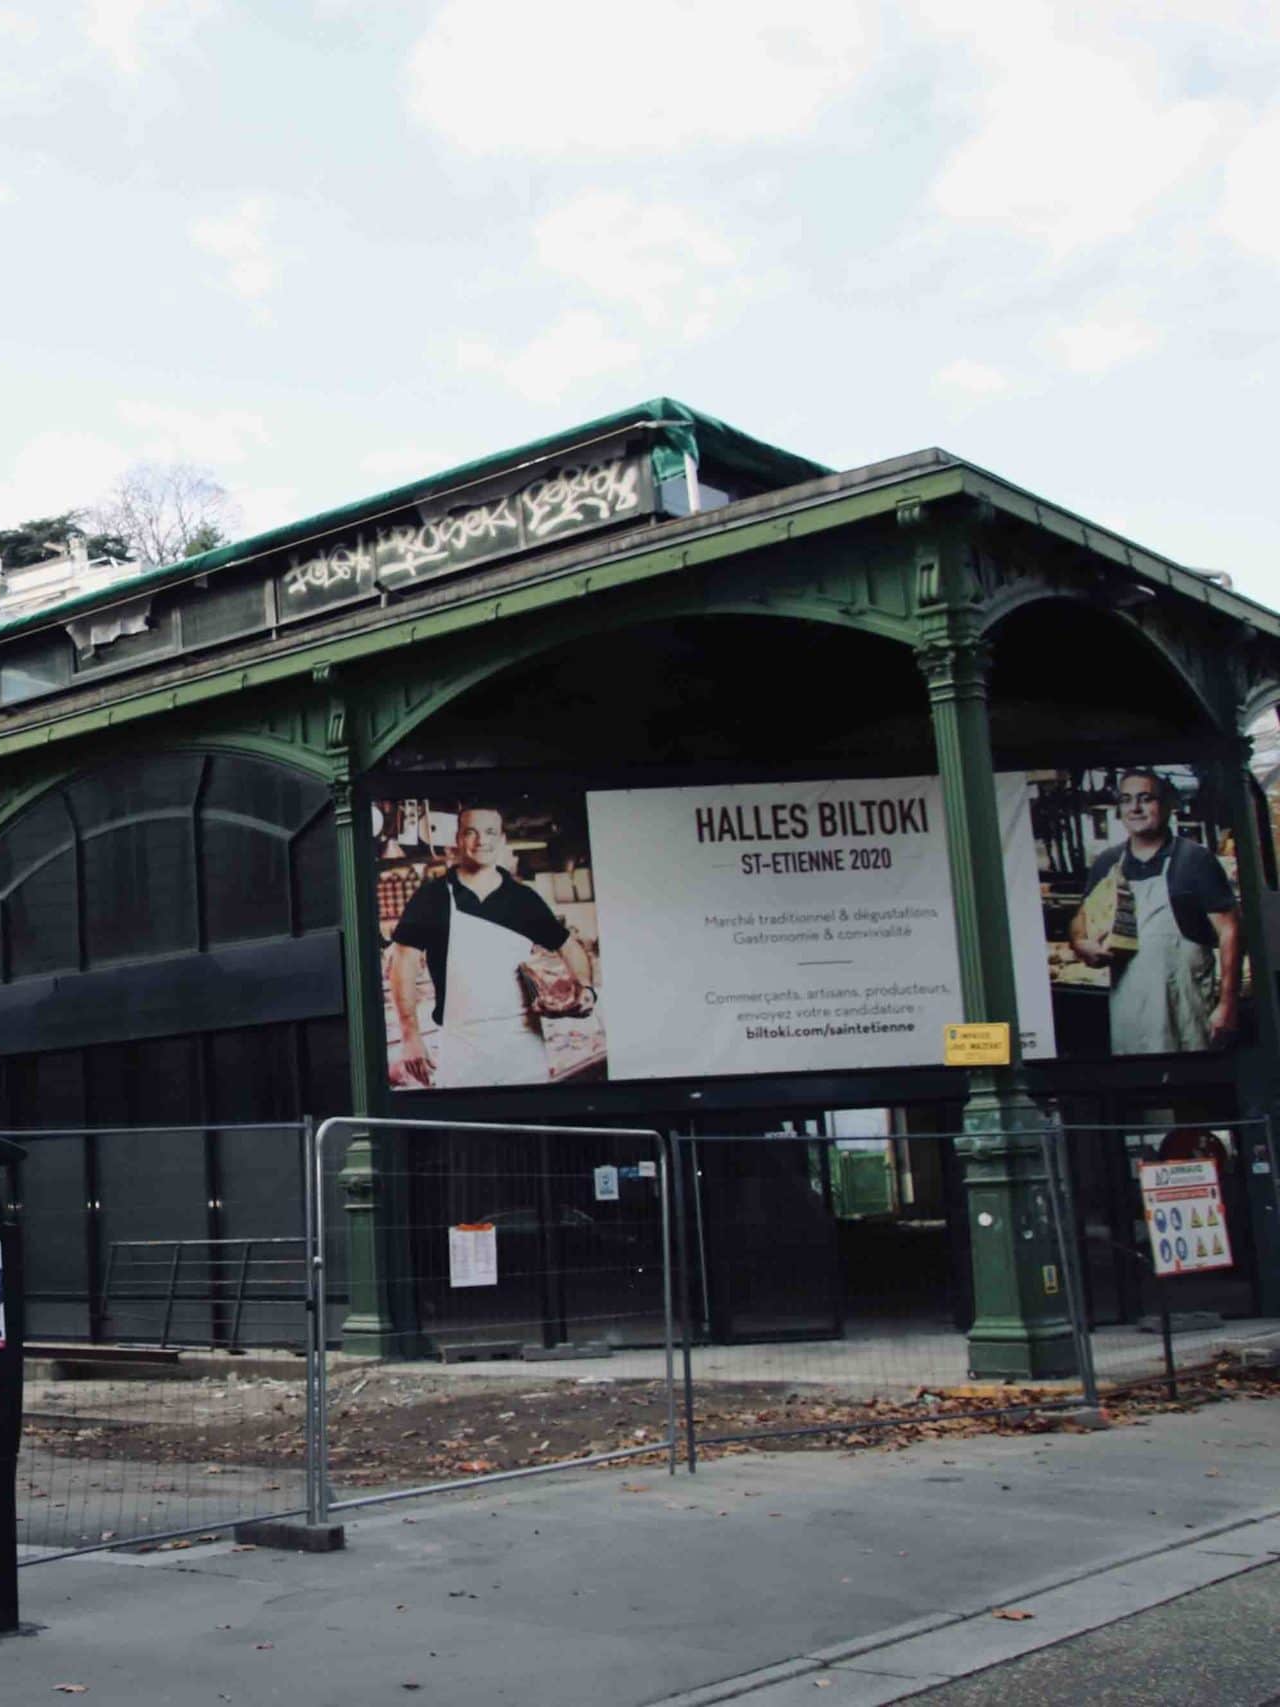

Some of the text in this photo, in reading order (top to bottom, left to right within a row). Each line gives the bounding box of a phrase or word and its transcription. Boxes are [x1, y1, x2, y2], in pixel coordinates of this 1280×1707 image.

[695, 797, 930, 843] HALLES BILTOKI
[742, 847, 892, 875] ST-ETIENNE 2020
[704, 905, 939, 928] Marché traditionnel & dégustations
[733, 924, 913, 945] Gastronomie & convivialité
[737, 1008, 792, 1023] envoyez
[796, 1006, 830, 1020] votre
[746, 1021, 916, 1040] biltoki.com/saintetienne
